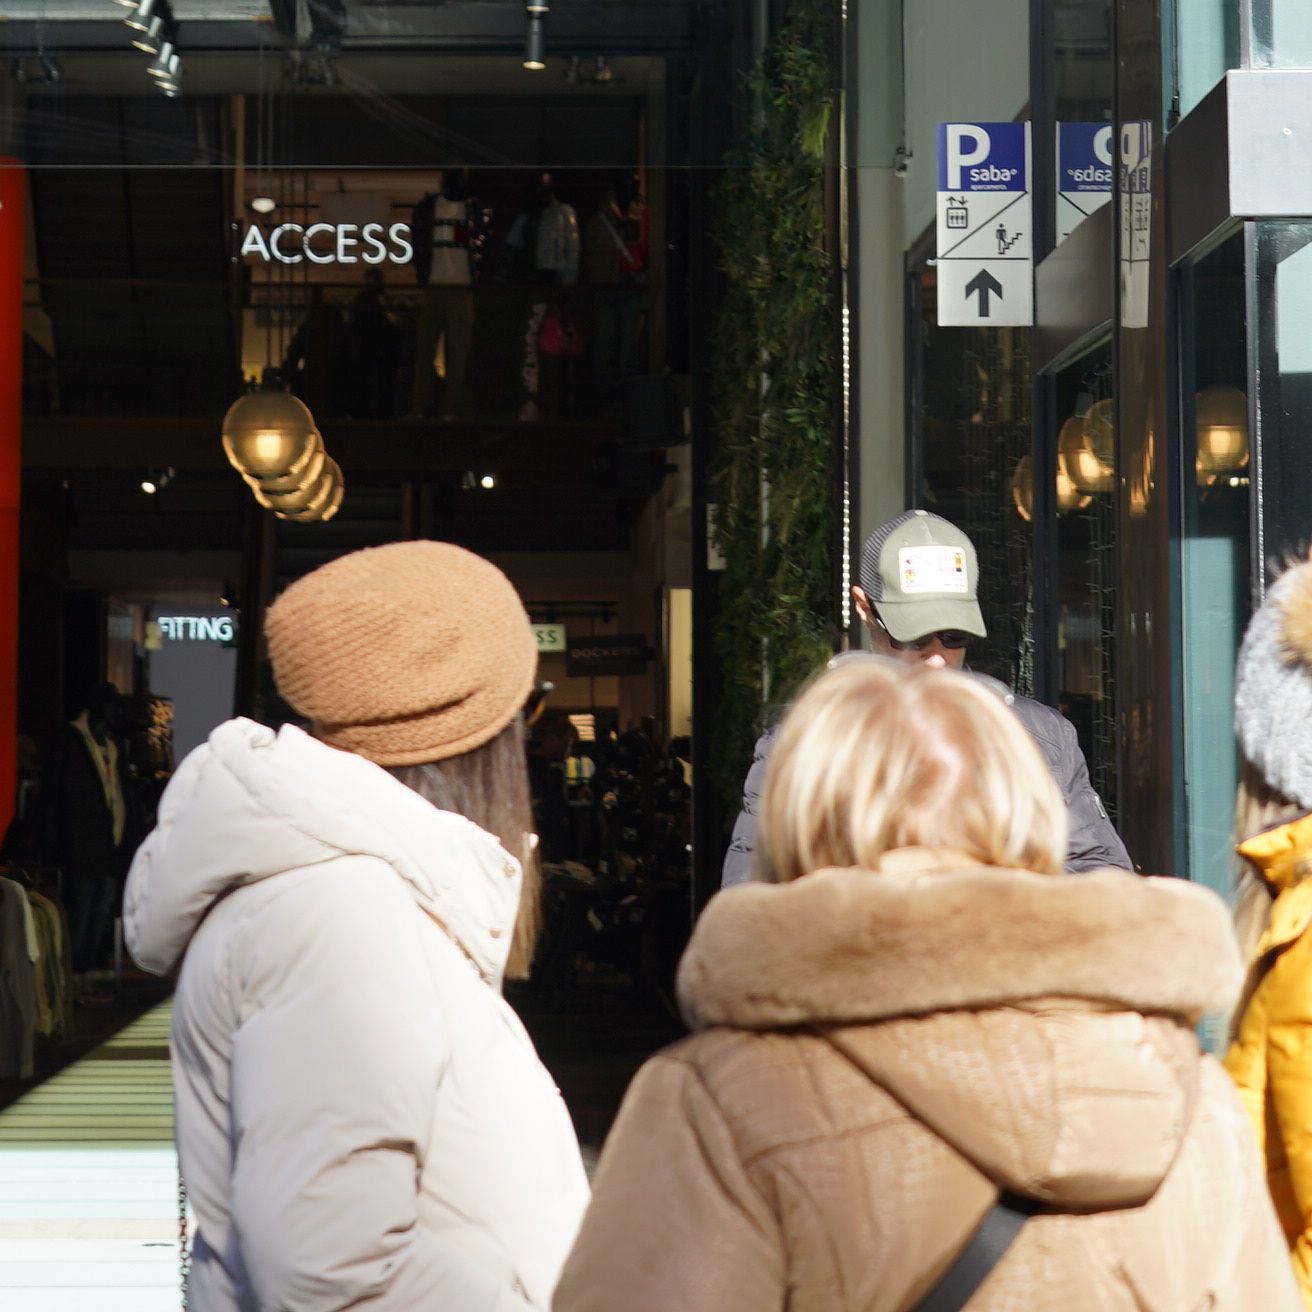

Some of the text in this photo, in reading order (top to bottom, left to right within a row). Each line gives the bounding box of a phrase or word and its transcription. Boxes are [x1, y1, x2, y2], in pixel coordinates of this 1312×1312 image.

[946, 124, 991, 189] P
[241, 222, 414, 265] ACCESS
[158, 616, 234, 641] FITTING
